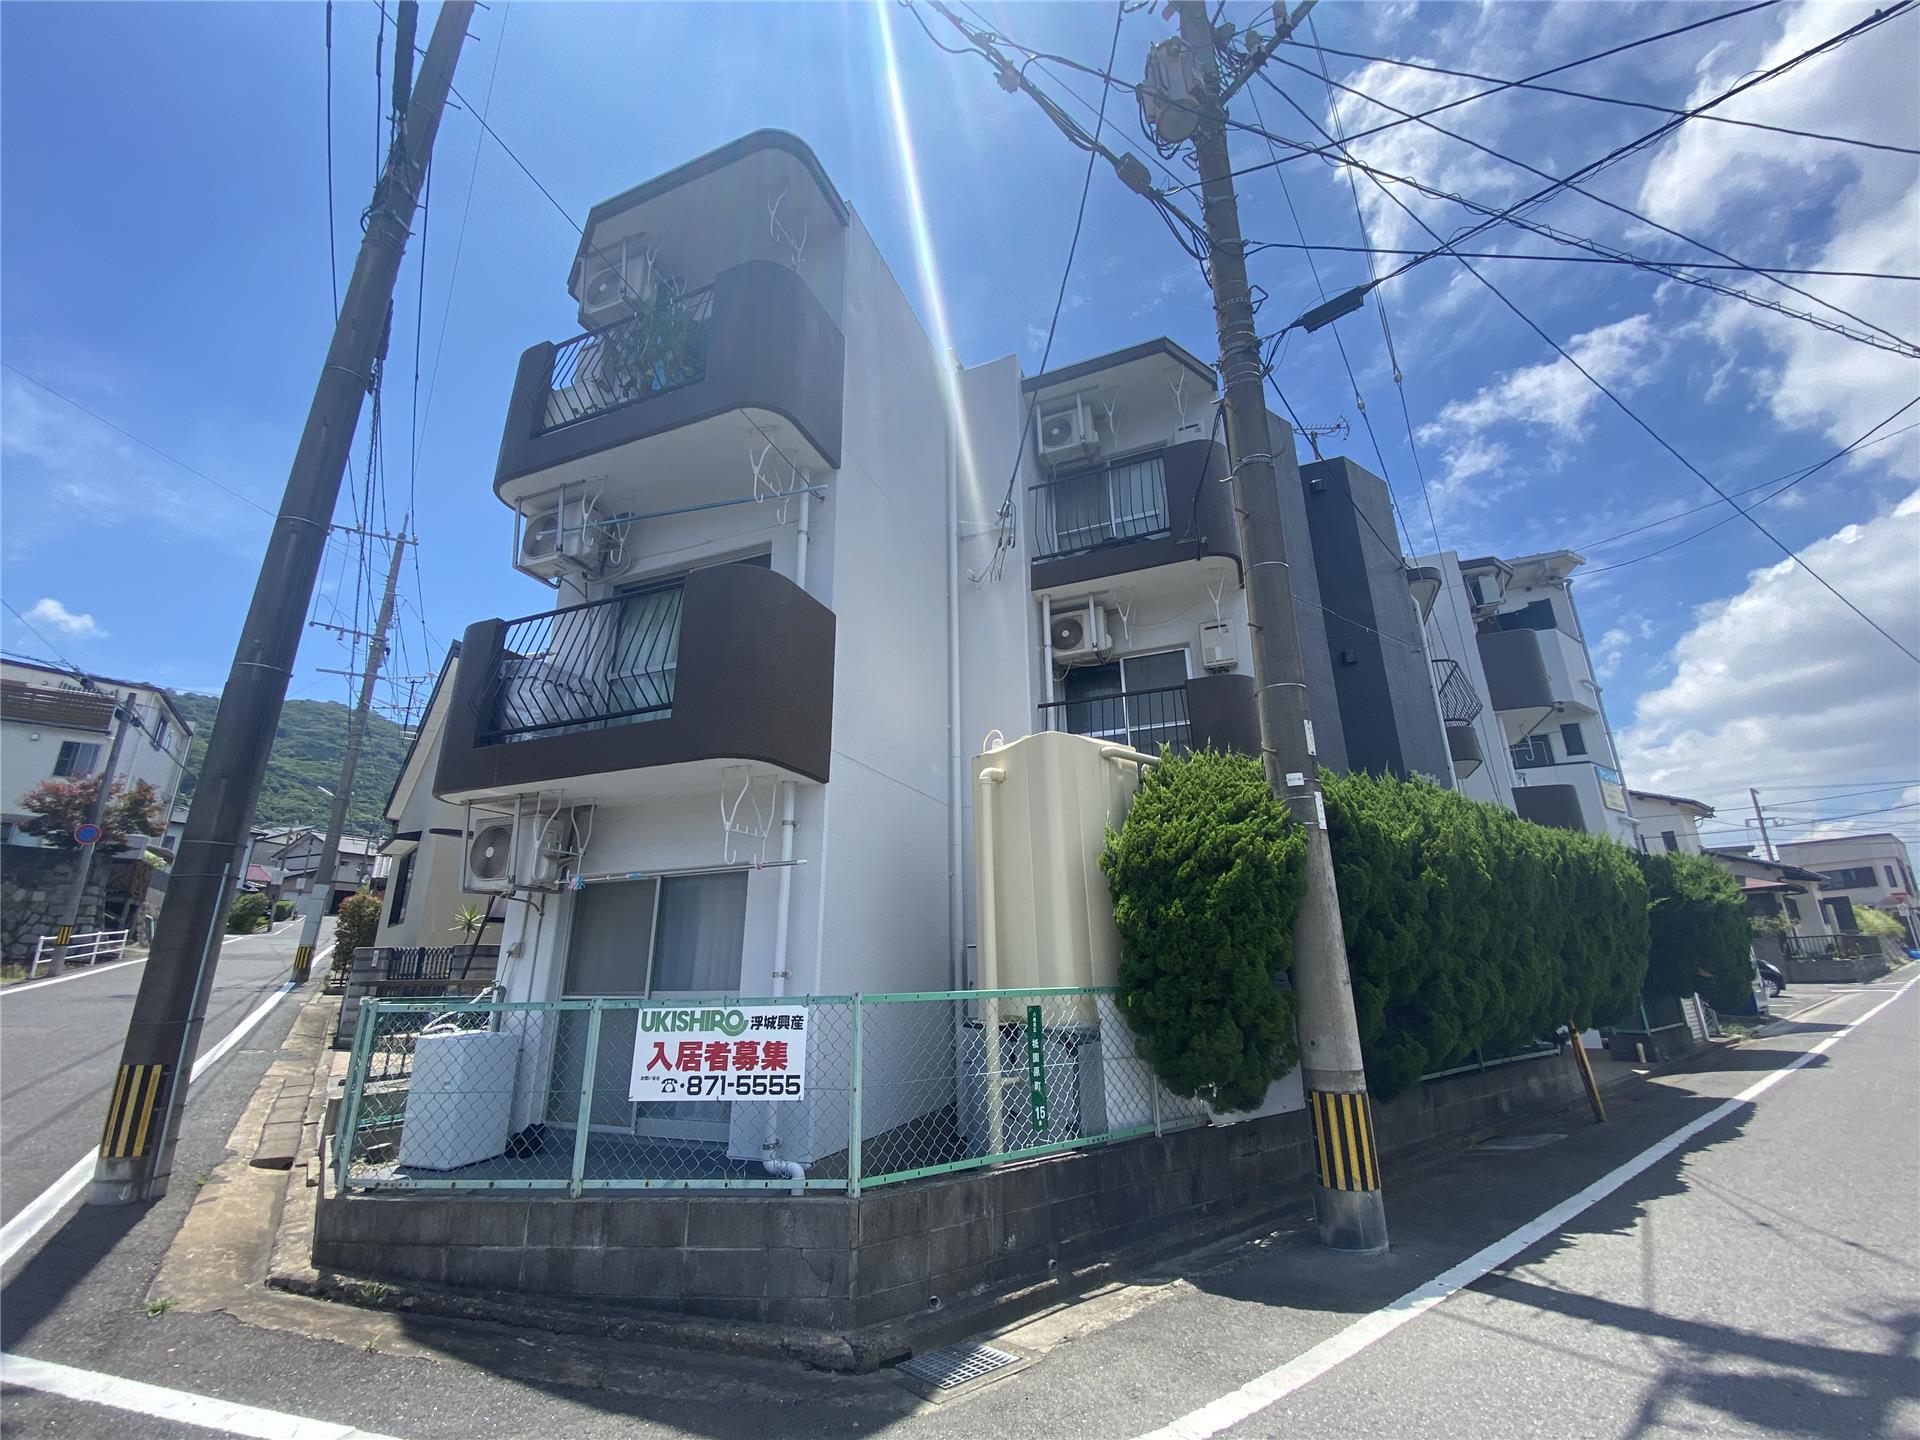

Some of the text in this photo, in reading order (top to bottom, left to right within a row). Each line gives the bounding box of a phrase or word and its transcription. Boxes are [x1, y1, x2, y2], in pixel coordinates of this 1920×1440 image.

[641, 1009, 804, 1037] UKISHIRO 浮城興産
[646, 1040, 788, 1072] 入居者募集
[1035, 1106, 1046, 1119] 15
